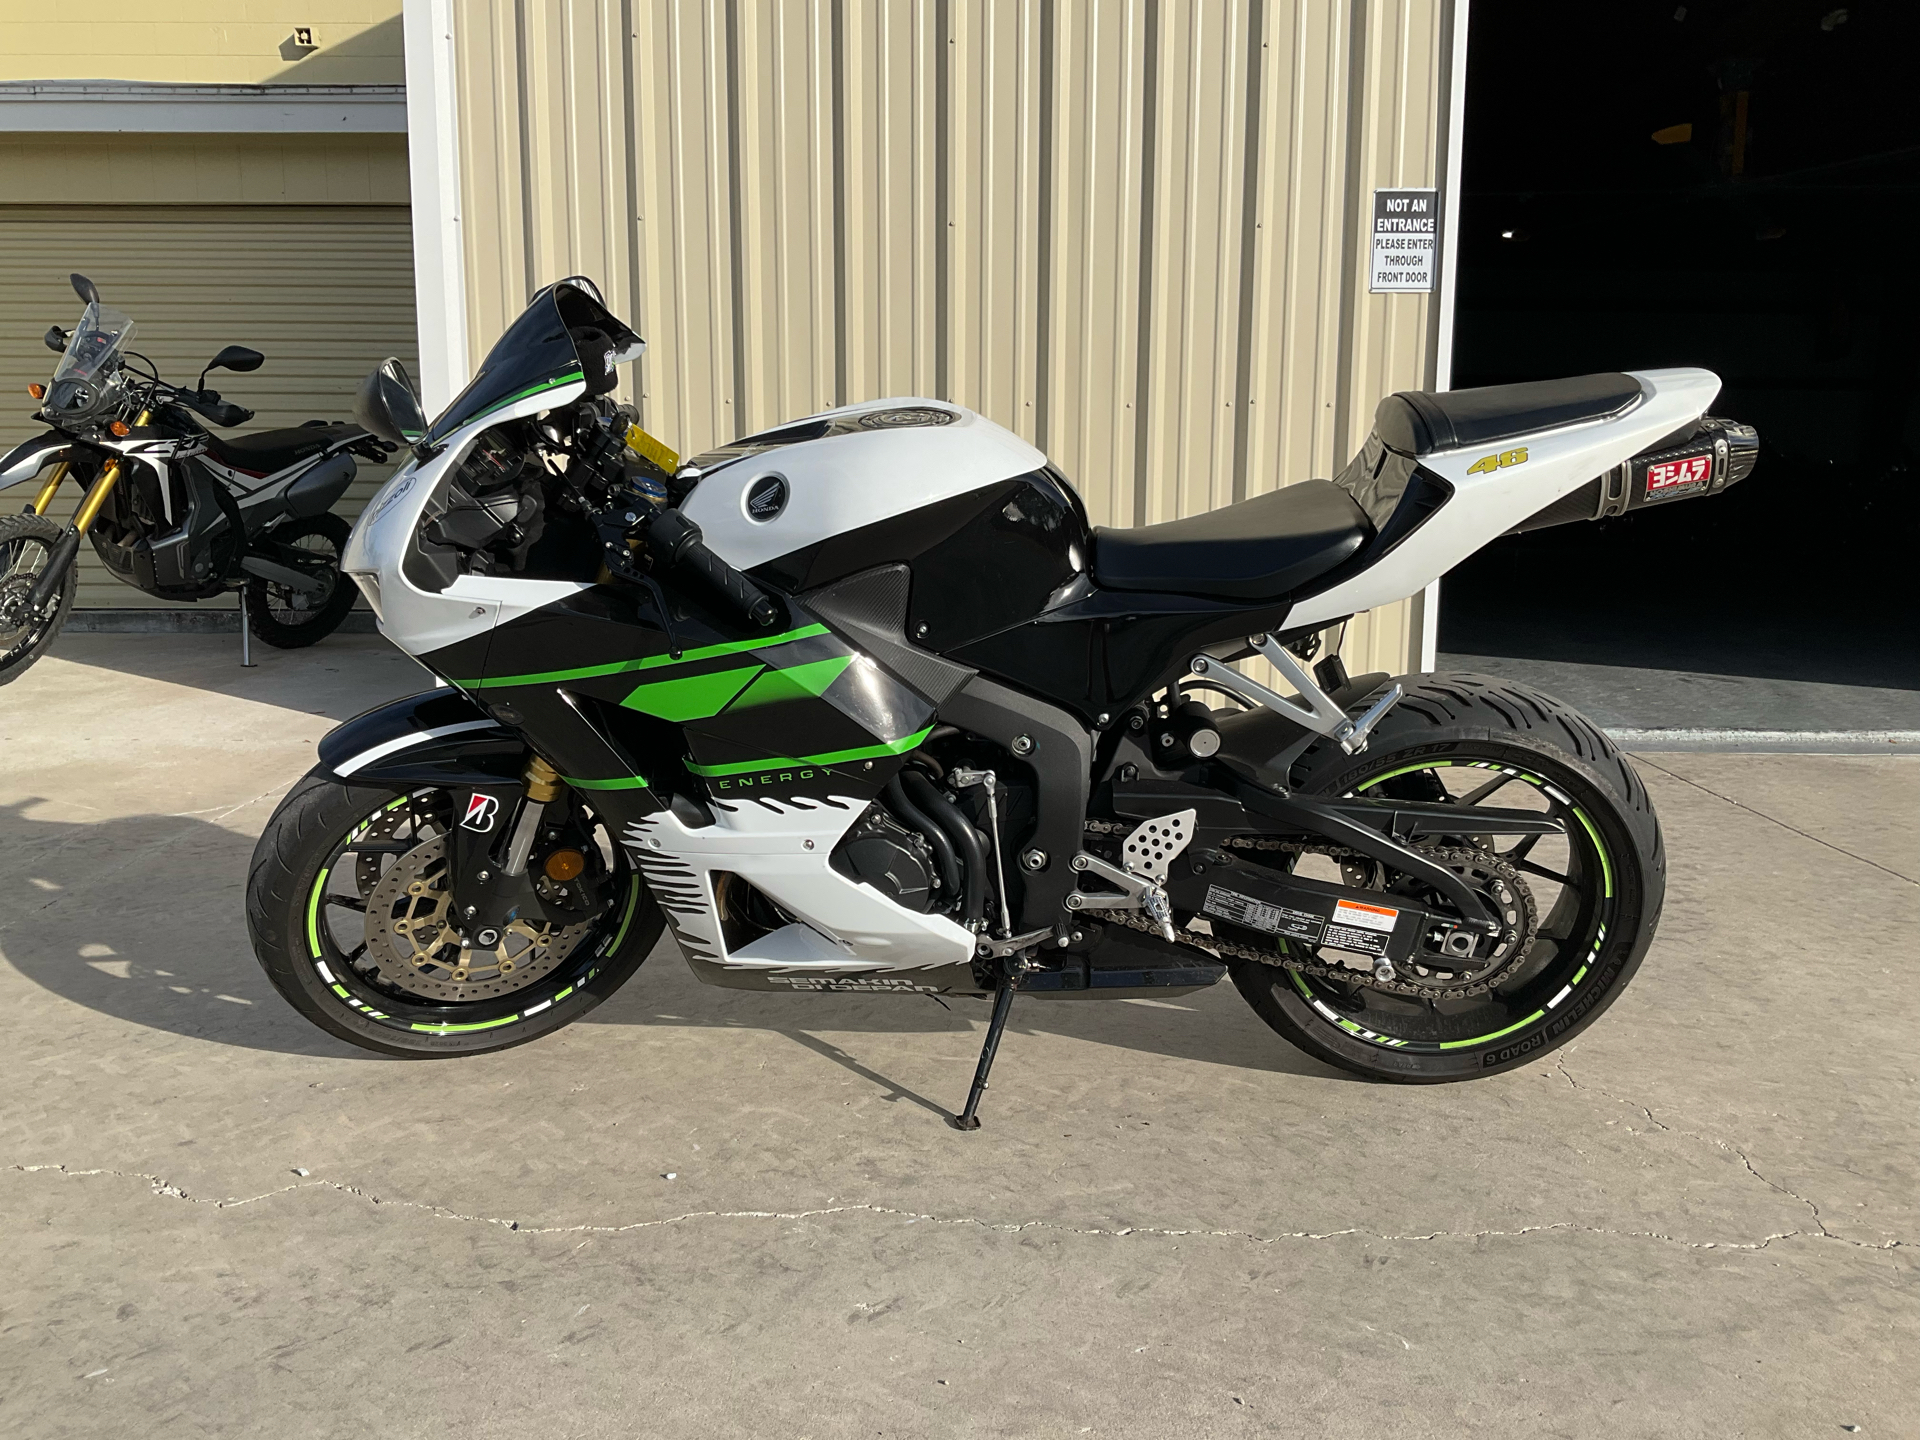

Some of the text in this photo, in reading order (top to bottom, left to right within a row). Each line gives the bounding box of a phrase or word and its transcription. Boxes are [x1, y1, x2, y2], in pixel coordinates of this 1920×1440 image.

[1386, 199, 1427, 212] NOT AN
[1377, 218, 1434, 232] ENTRANCE
[1375, 239, 1433, 250] PLEASE ENTER
[1384, 255, 1423, 266] THROUGH
[1377, 272, 1428, 283] FRONT DOOR
[1467, 447, 1528, 475] 46
[1652, 459, 1705, 488] ヨシムラ
[752, 505, 779, 514] HONDA
[1341, 754, 1397, 783] 180/55
[1402, 747, 1425, 758] ZR
[1431, 743, 1449, 752] 17
[719, 768, 832, 789] ENERGY
[574, 877, 590, 906] TOKICO
[1359, 905, 1380, 913] WARNING
[767, 976, 914, 985] SEMAKIN
[829, 984, 939, 992] DEPAN
[1485, 966, 1616, 1064] MICHELIN ROAD 6
